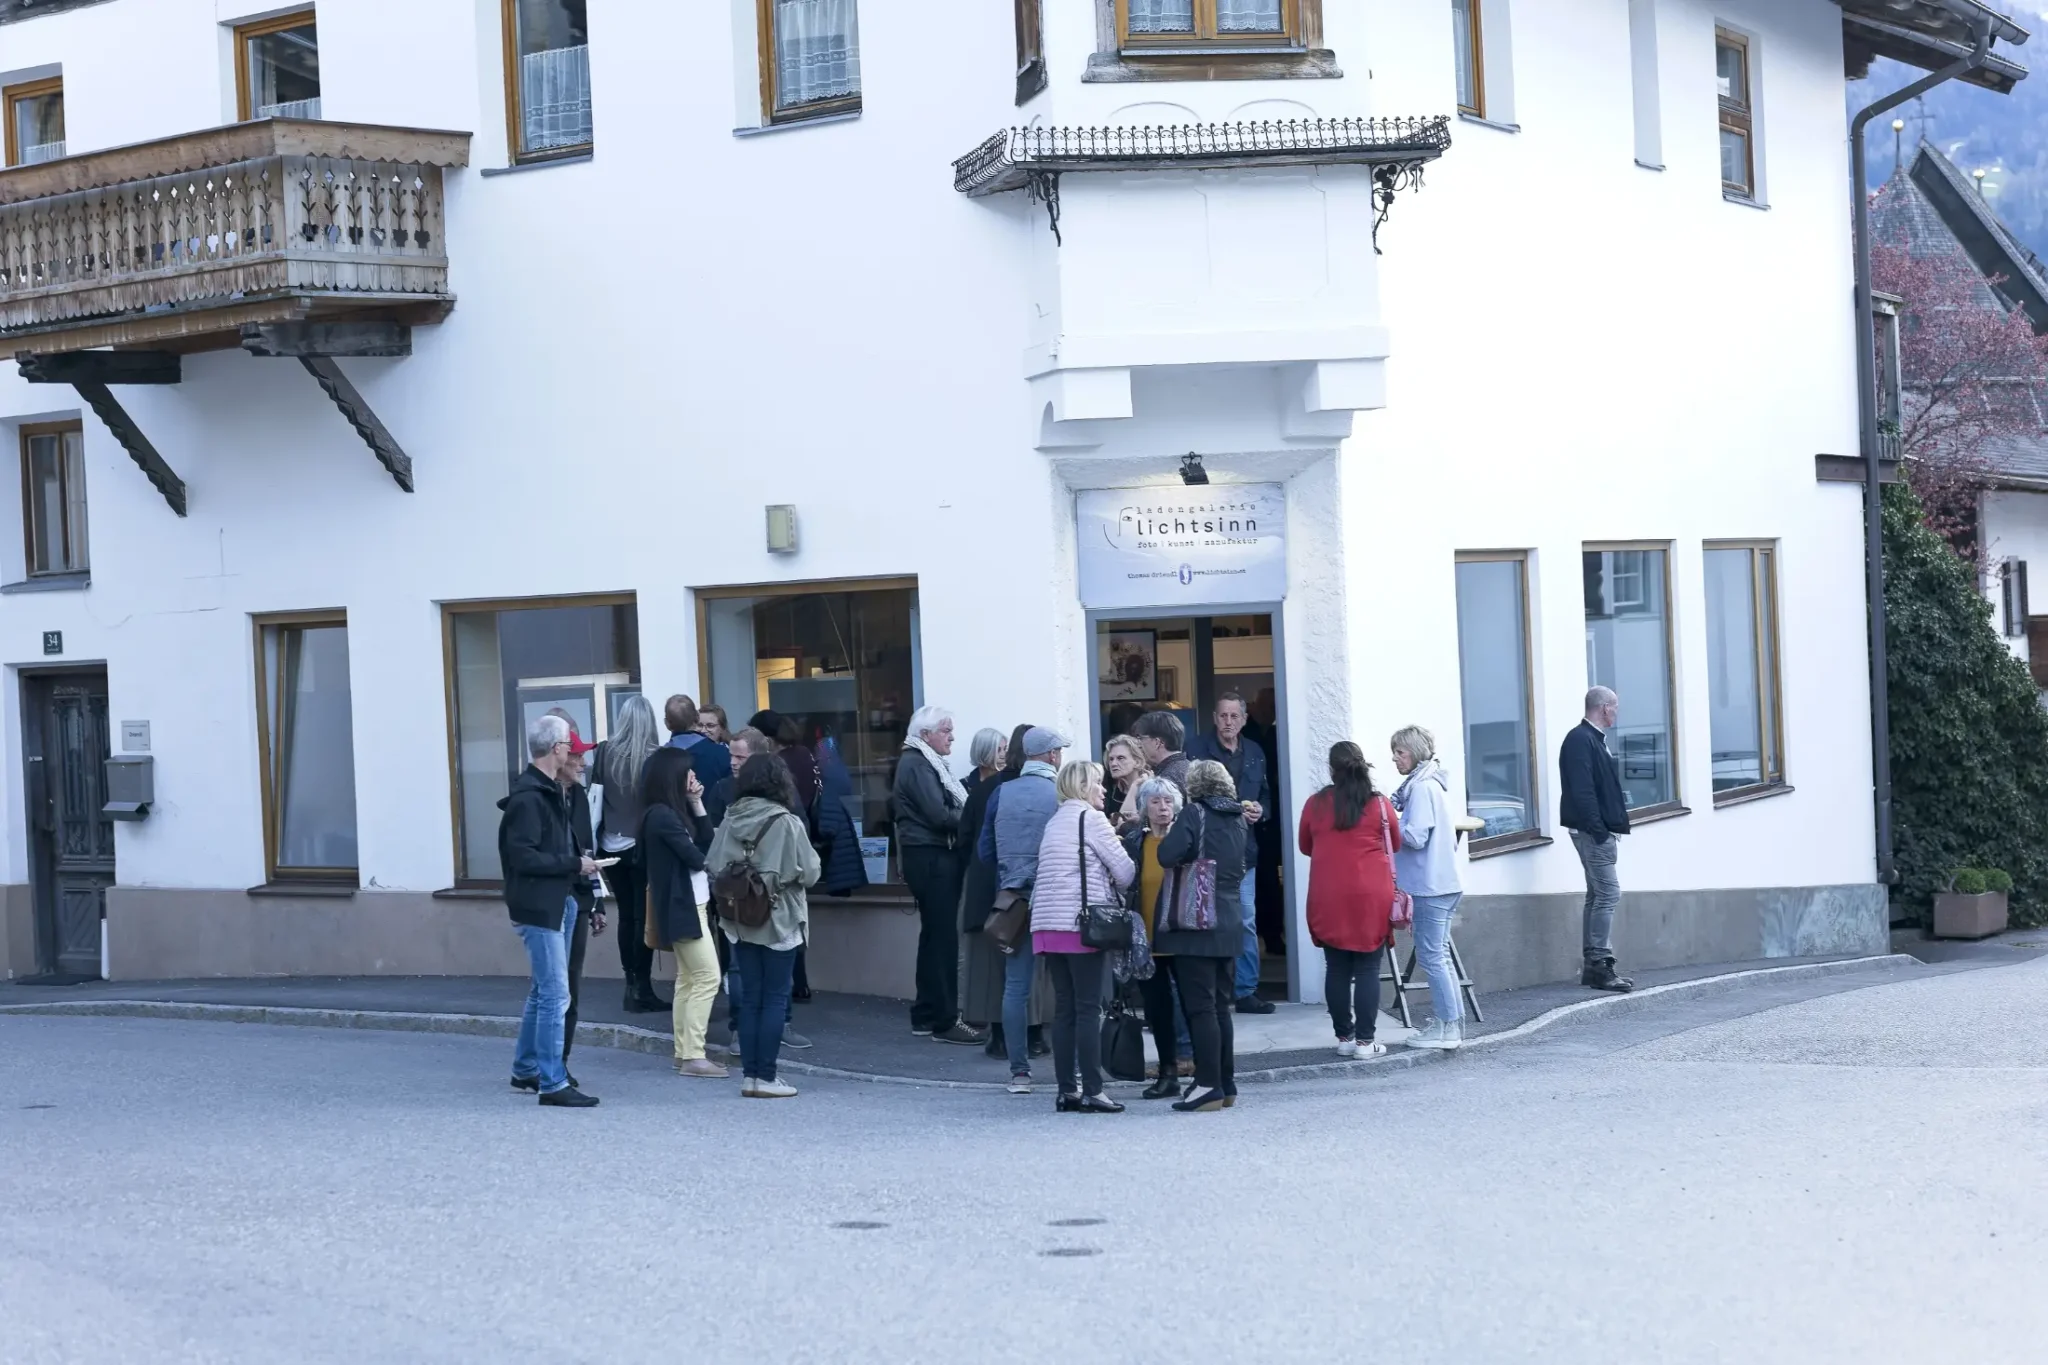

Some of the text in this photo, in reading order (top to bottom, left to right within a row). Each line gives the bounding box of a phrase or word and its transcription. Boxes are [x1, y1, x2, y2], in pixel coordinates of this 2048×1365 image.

[1136, 503, 1256, 515] ladengalerie
[1137, 517, 1257, 535] lichtsinn
[1137, 537, 1259, 549] foto kunst manufaktur
[47, 634, 58, 647] 34
